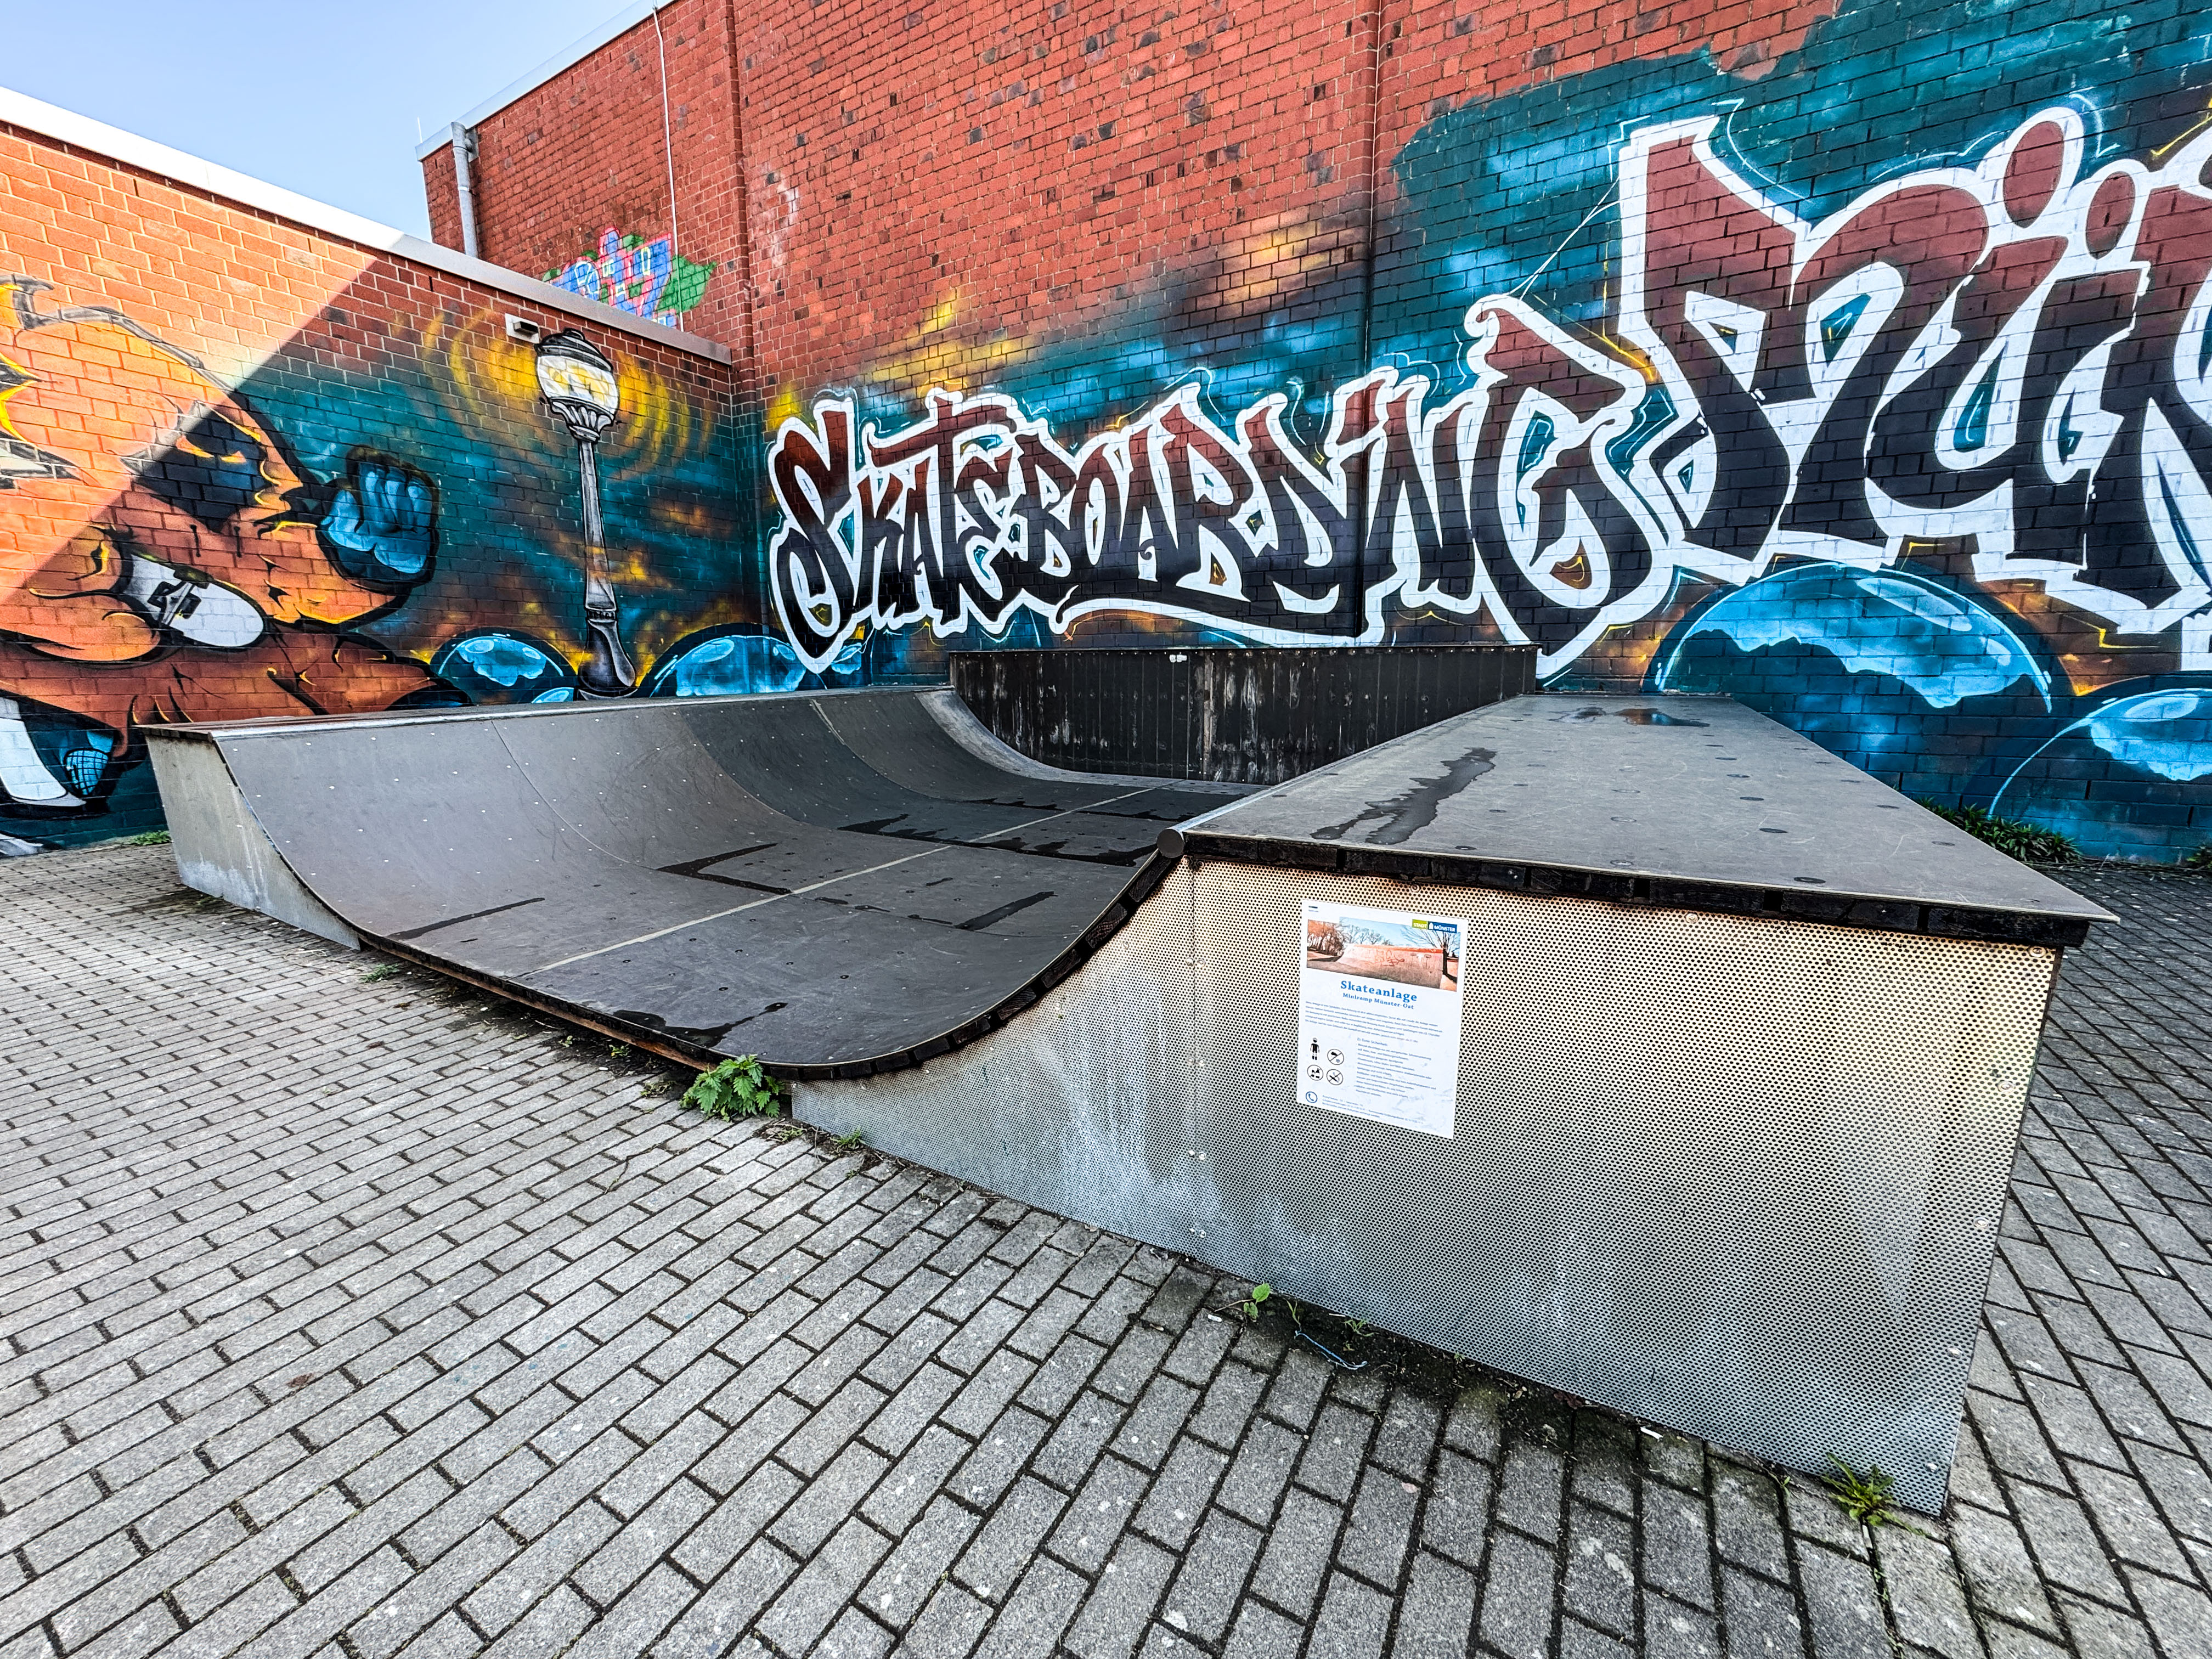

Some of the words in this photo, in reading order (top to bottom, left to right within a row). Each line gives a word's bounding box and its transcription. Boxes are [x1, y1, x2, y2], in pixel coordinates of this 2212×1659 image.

[1340, 980, 1418, 1003] Skateanlage
[1342, 992, 1372, 1003] Miniramp
[1374, 998, 1414, 1009] Münster-Ost
